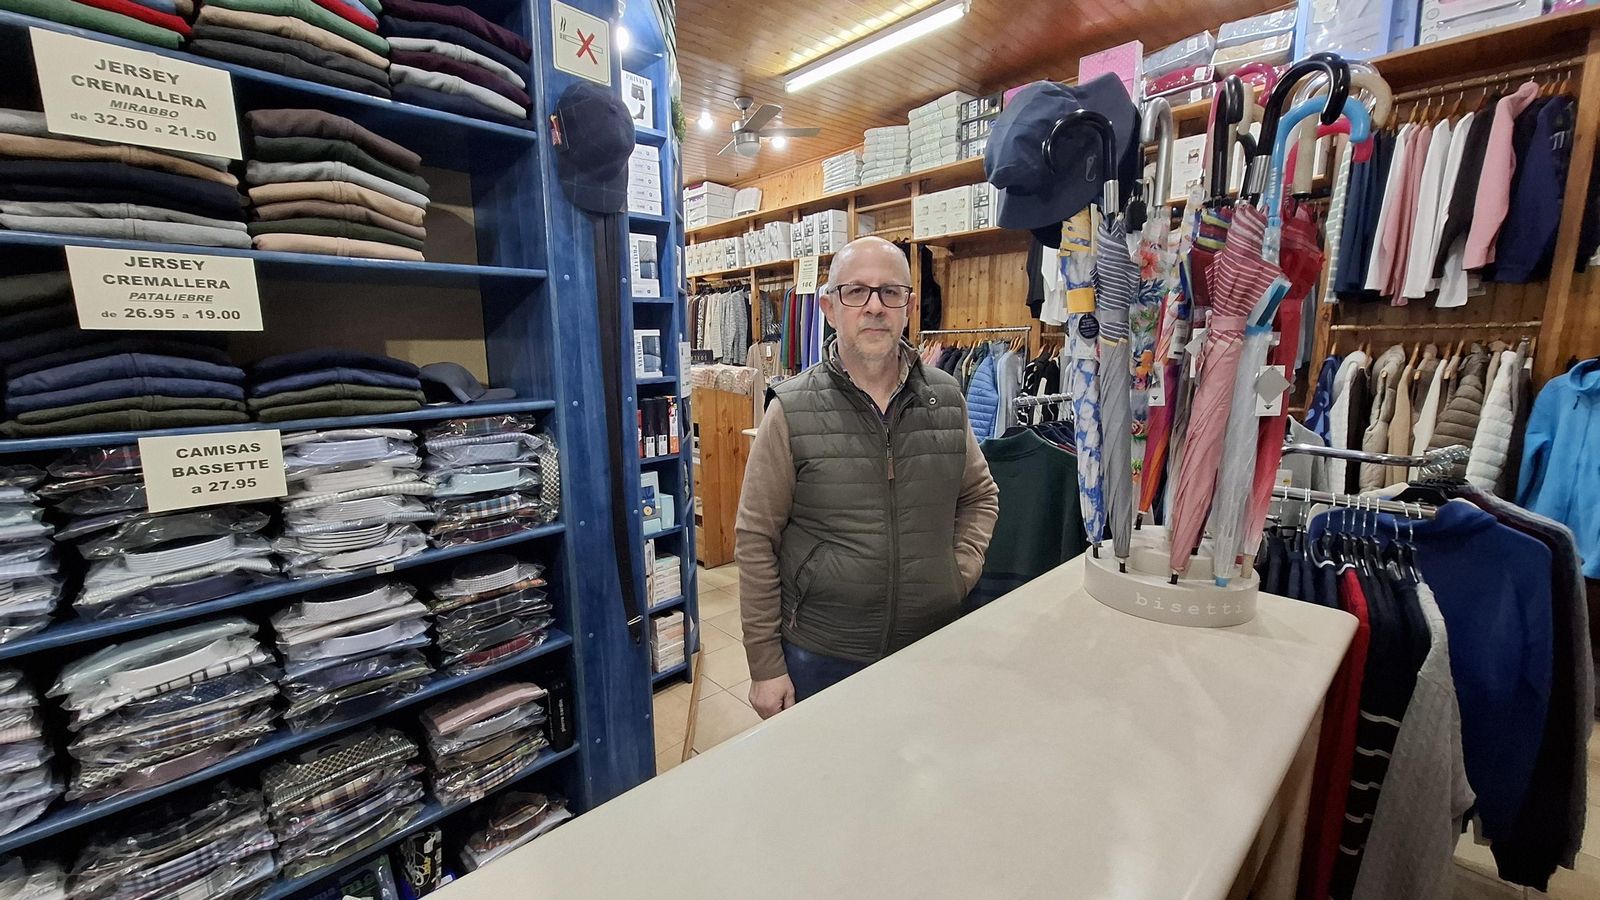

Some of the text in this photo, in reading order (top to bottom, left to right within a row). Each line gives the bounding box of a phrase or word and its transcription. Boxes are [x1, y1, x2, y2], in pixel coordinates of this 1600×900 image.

[94, 58, 180, 85] JERSEY
[71, 74, 207, 110] CREMALLERA
[109, 99, 180, 119] MIRABBO
[70, 111, 217, 142] de 32.50 a 21.50
[124, 256, 205, 271] JERSEY
[102, 274, 231, 290] CREMALLERA
[128, 292, 214, 303] PATALIEBRE
[101, 310, 117, 318] de
[124, 308, 175, 319] 26.95
[195, 309, 241, 320] 19.00
[176, 442, 262, 459] CAMISAS
[172, 459, 270, 478] BASSETTE
[191, 477, 257, 494] a 27.95
[1135, 591, 1245, 616] bisetti
